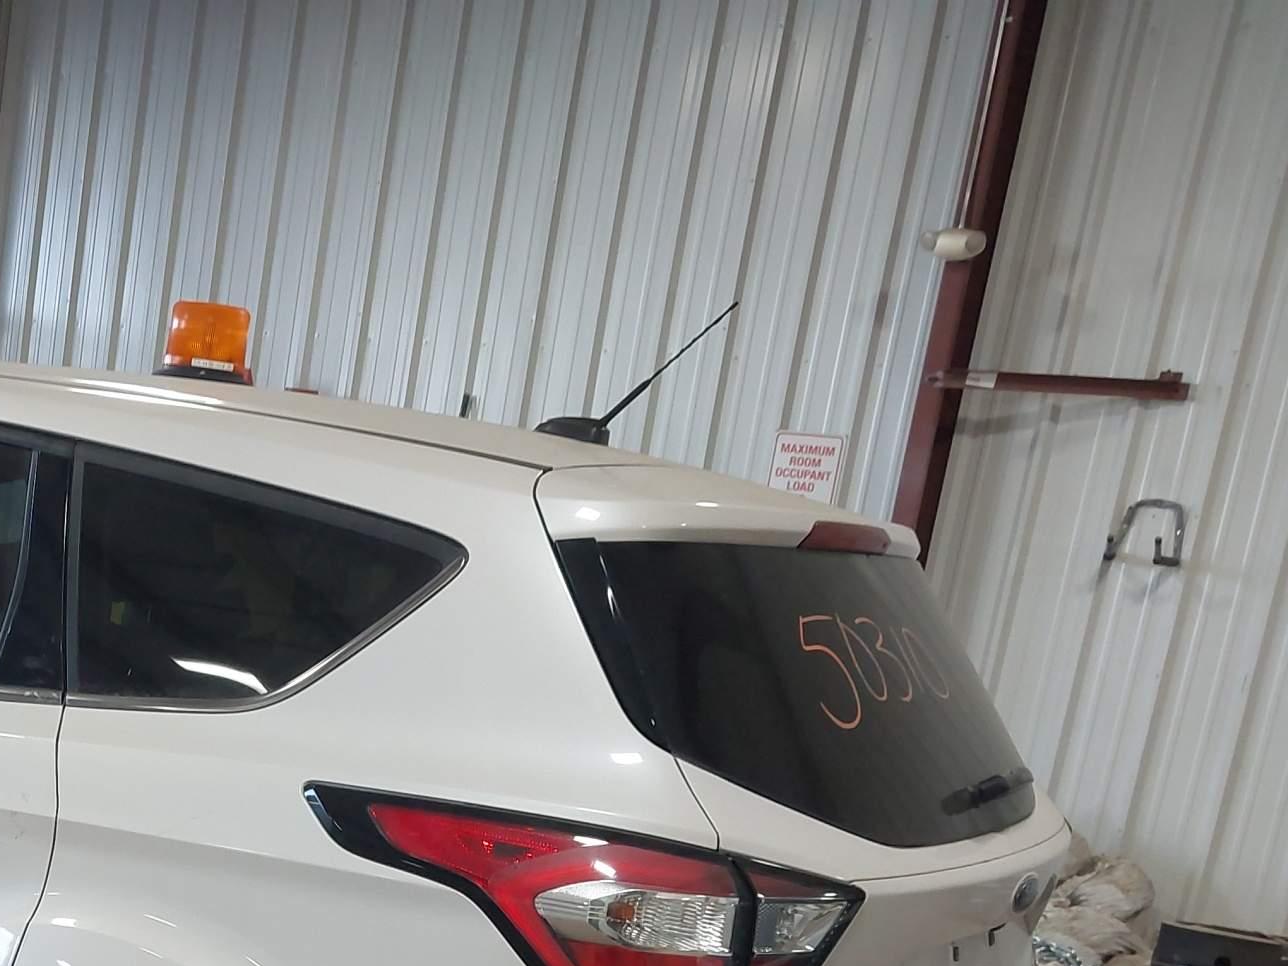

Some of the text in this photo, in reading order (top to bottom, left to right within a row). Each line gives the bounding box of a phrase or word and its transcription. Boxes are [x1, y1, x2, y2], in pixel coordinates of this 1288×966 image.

[780, 442, 836, 457] MAXIMUM
[788, 456, 822, 468] ROOM
[774, 467, 832, 482] OCCUPANT
[786, 480, 815, 493] LOAD
[799, 613, 950, 730] 50310
